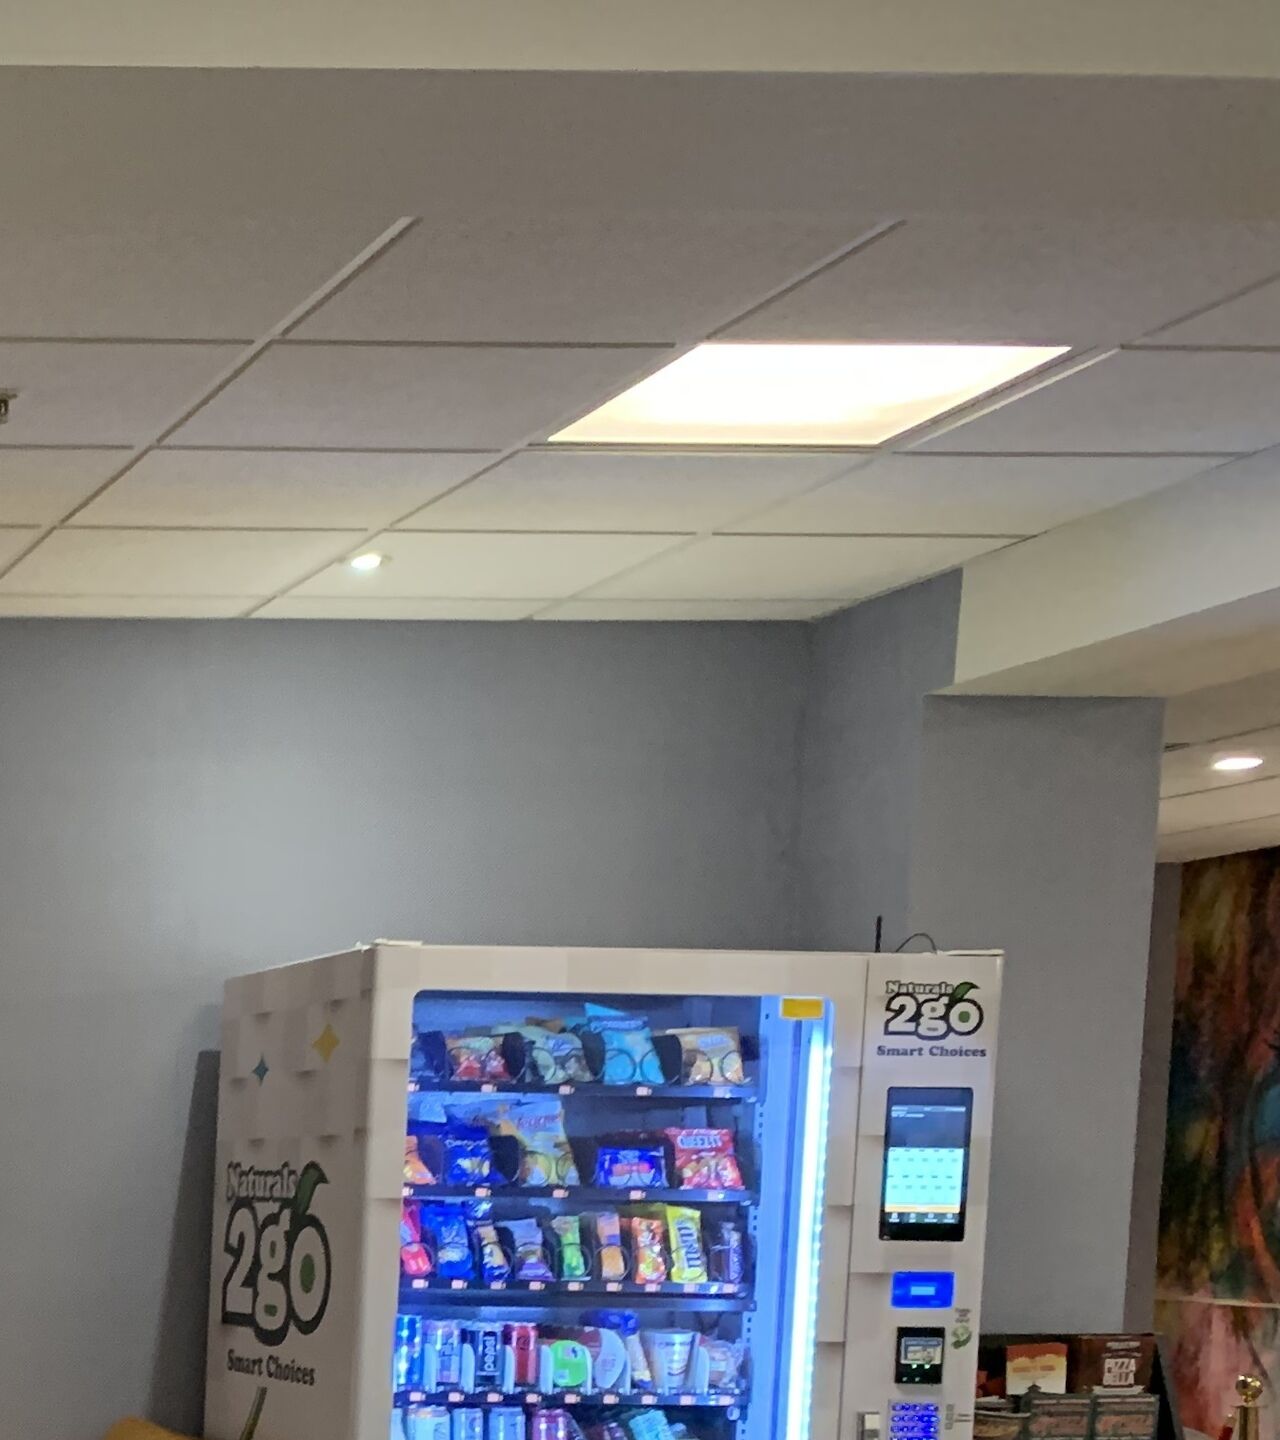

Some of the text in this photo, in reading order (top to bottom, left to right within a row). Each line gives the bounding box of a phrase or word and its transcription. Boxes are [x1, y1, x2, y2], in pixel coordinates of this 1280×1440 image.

[885, 980, 954, 995] Naturals
[883, 993, 984, 1041] 2go
[876, 1045, 987, 1057] Smart Choices
[227, 1161, 298, 1202] Naturals
[222, 1200, 331, 1347] 2go
[227, 1349, 316, 1386] Smart Choices
